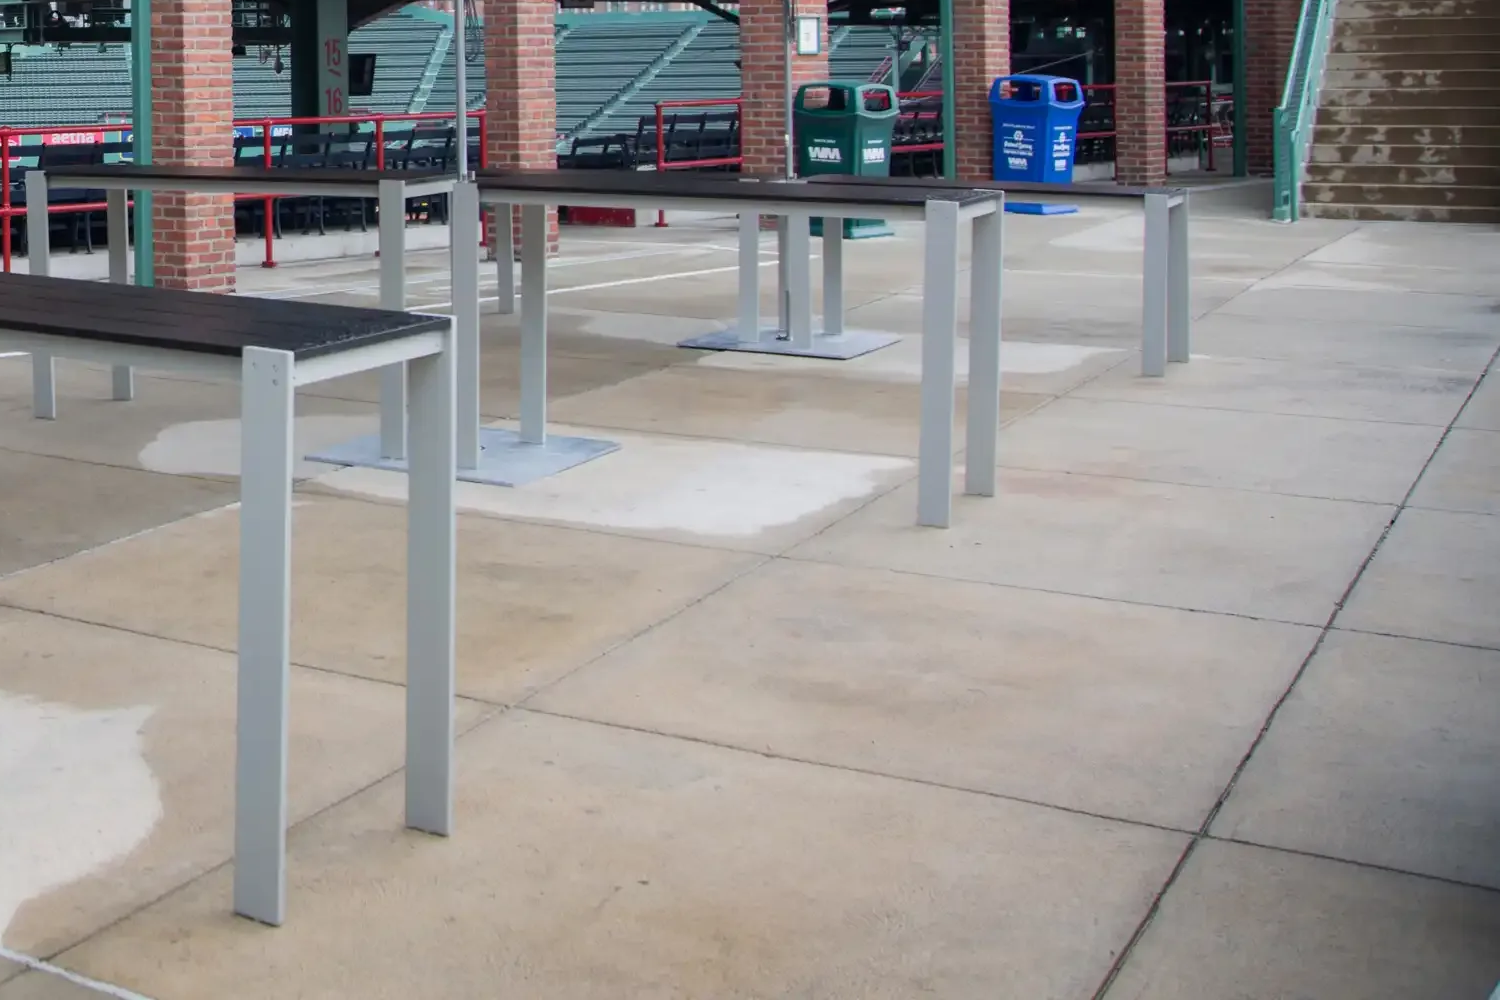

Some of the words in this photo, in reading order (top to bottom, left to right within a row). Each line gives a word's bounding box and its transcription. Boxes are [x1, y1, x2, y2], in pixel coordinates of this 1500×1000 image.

[324, 38, 341, 66] 15
[325, 87, 343, 114] 16
[51, 132, 96, 144] aetna
